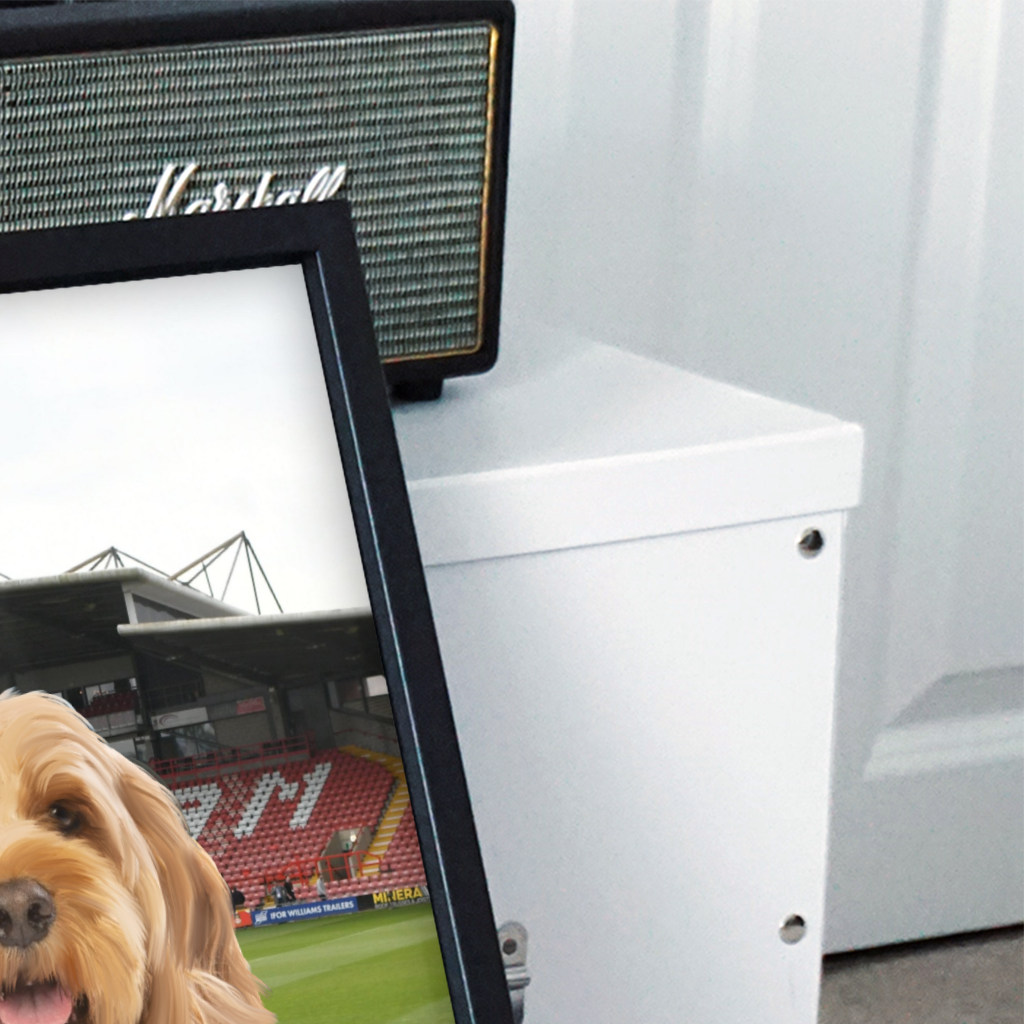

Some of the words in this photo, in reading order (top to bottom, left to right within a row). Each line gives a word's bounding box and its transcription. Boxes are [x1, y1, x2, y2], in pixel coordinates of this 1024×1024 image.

[270, 910, 287, 920] IFOR
[287, 905, 322, 917] WILLIAMS
[322, 900, 355, 912] TRAILERS
